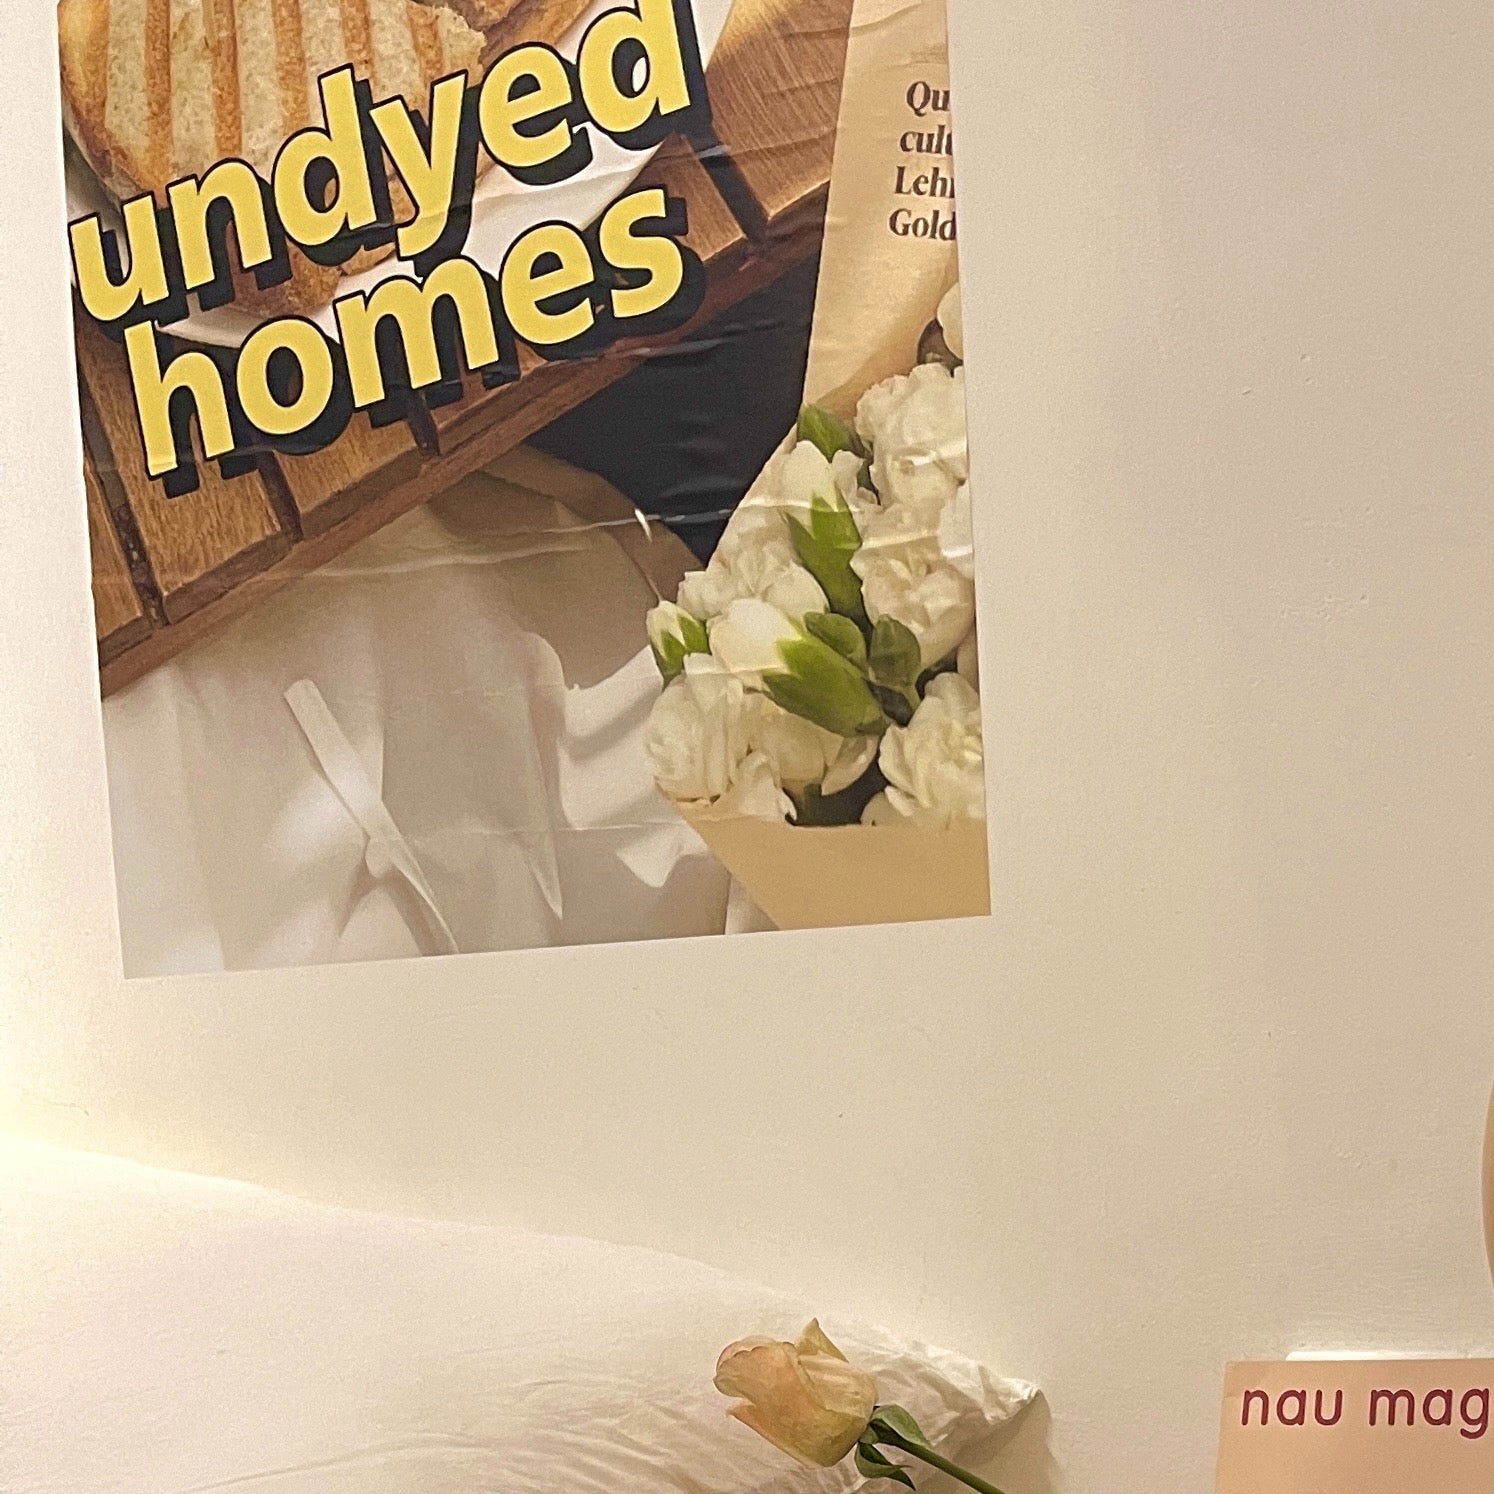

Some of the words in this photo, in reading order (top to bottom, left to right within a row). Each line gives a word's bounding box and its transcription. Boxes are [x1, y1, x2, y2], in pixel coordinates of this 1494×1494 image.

[68, 0, 692, 324] undyed
[888, 208, 957, 241] Gold
[122, 186, 690, 482] homes
[1241, 1389, 1344, 1427] nau
